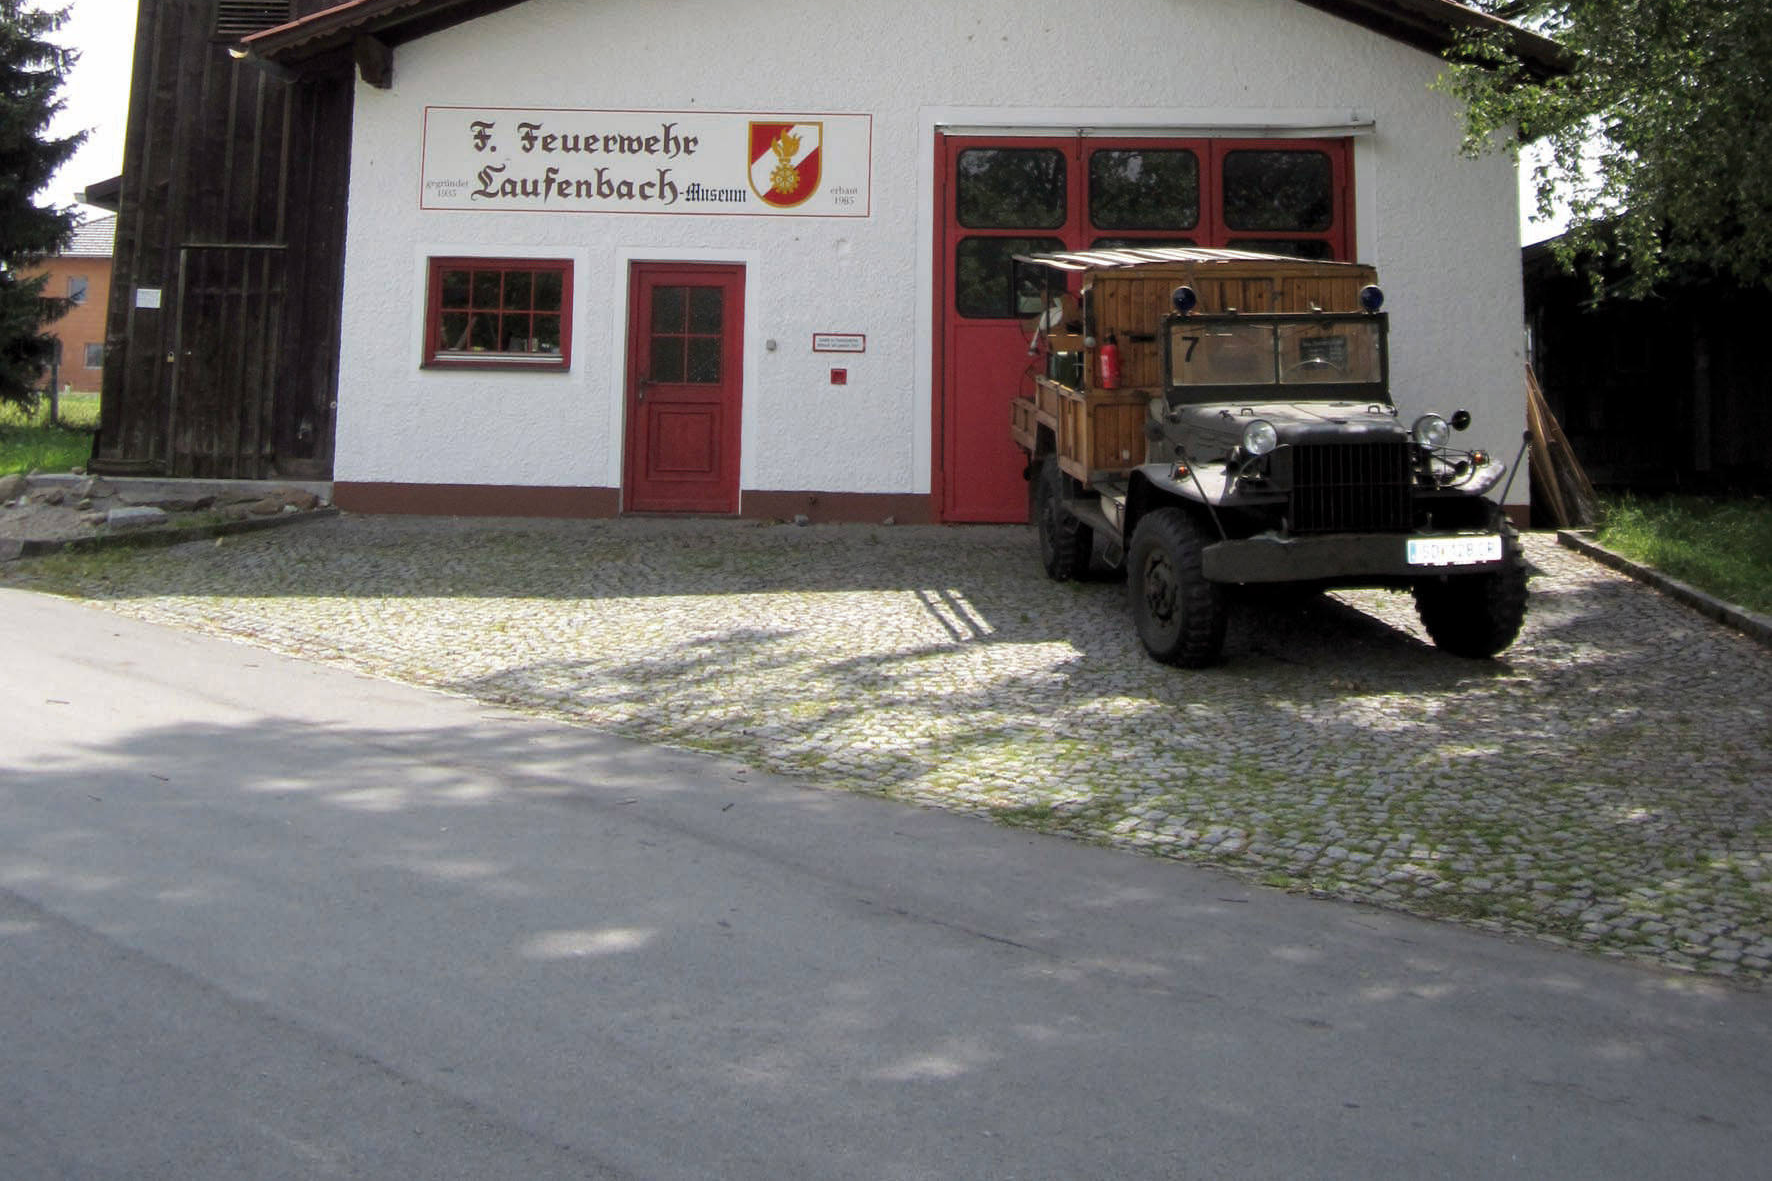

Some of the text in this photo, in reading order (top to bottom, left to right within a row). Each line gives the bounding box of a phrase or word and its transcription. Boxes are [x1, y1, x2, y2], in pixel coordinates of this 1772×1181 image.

[470, 121, 699, 159] F. Feuerwehr
[1181, 336, 1199, 363] 7
